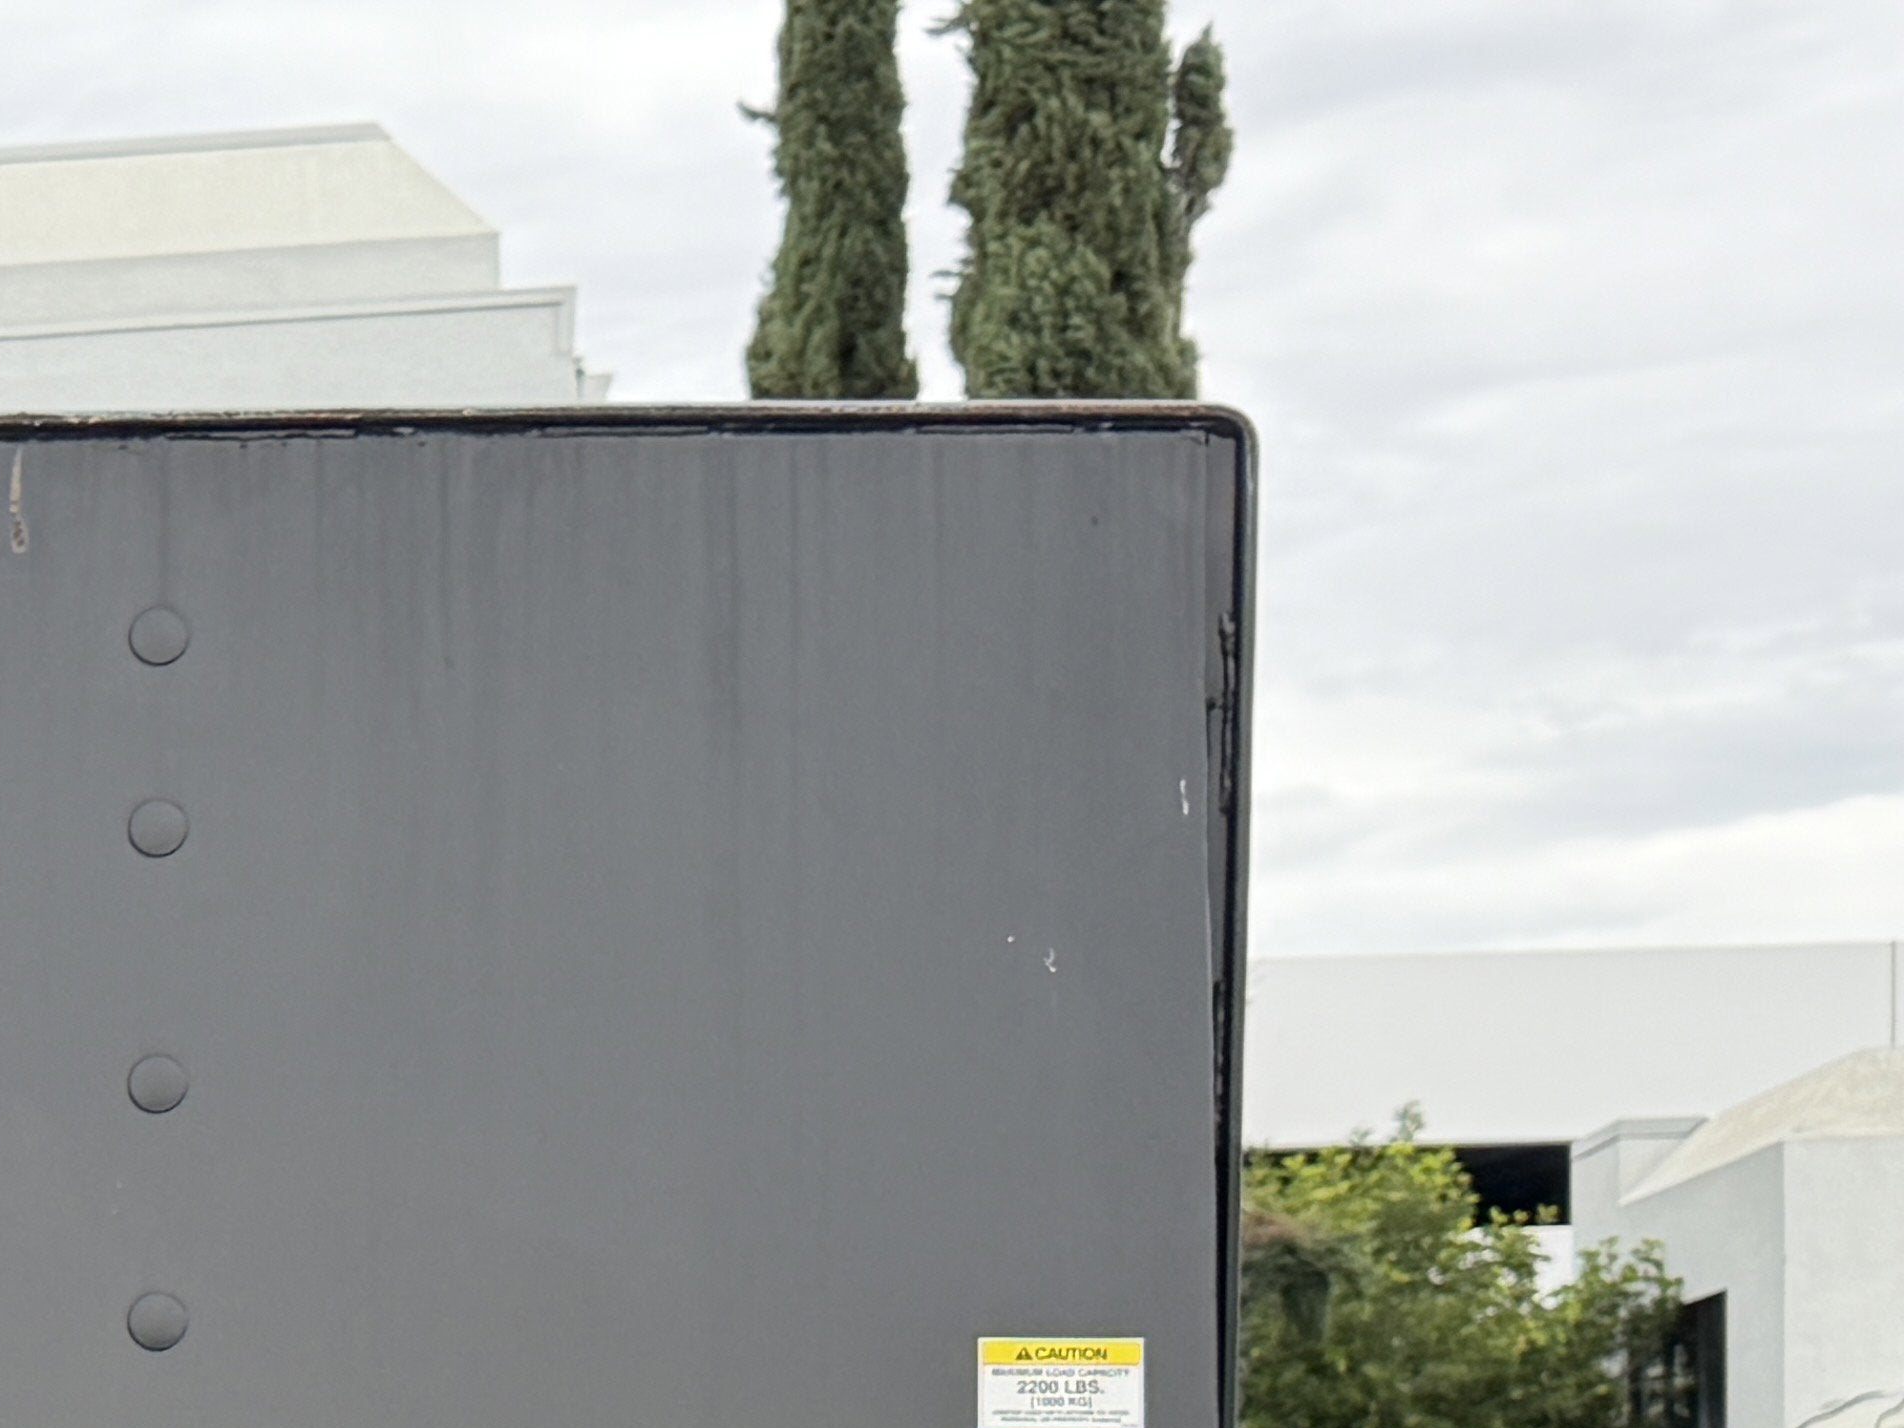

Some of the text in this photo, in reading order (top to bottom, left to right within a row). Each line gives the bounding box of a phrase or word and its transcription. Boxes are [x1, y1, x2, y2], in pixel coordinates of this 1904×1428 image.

[1035, 1347, 1108, 1360] CAUTION
[1046, 1368, 1075, 1377] LOAD
[1017, 1380, 1105, 1394] 2200 LBS.
